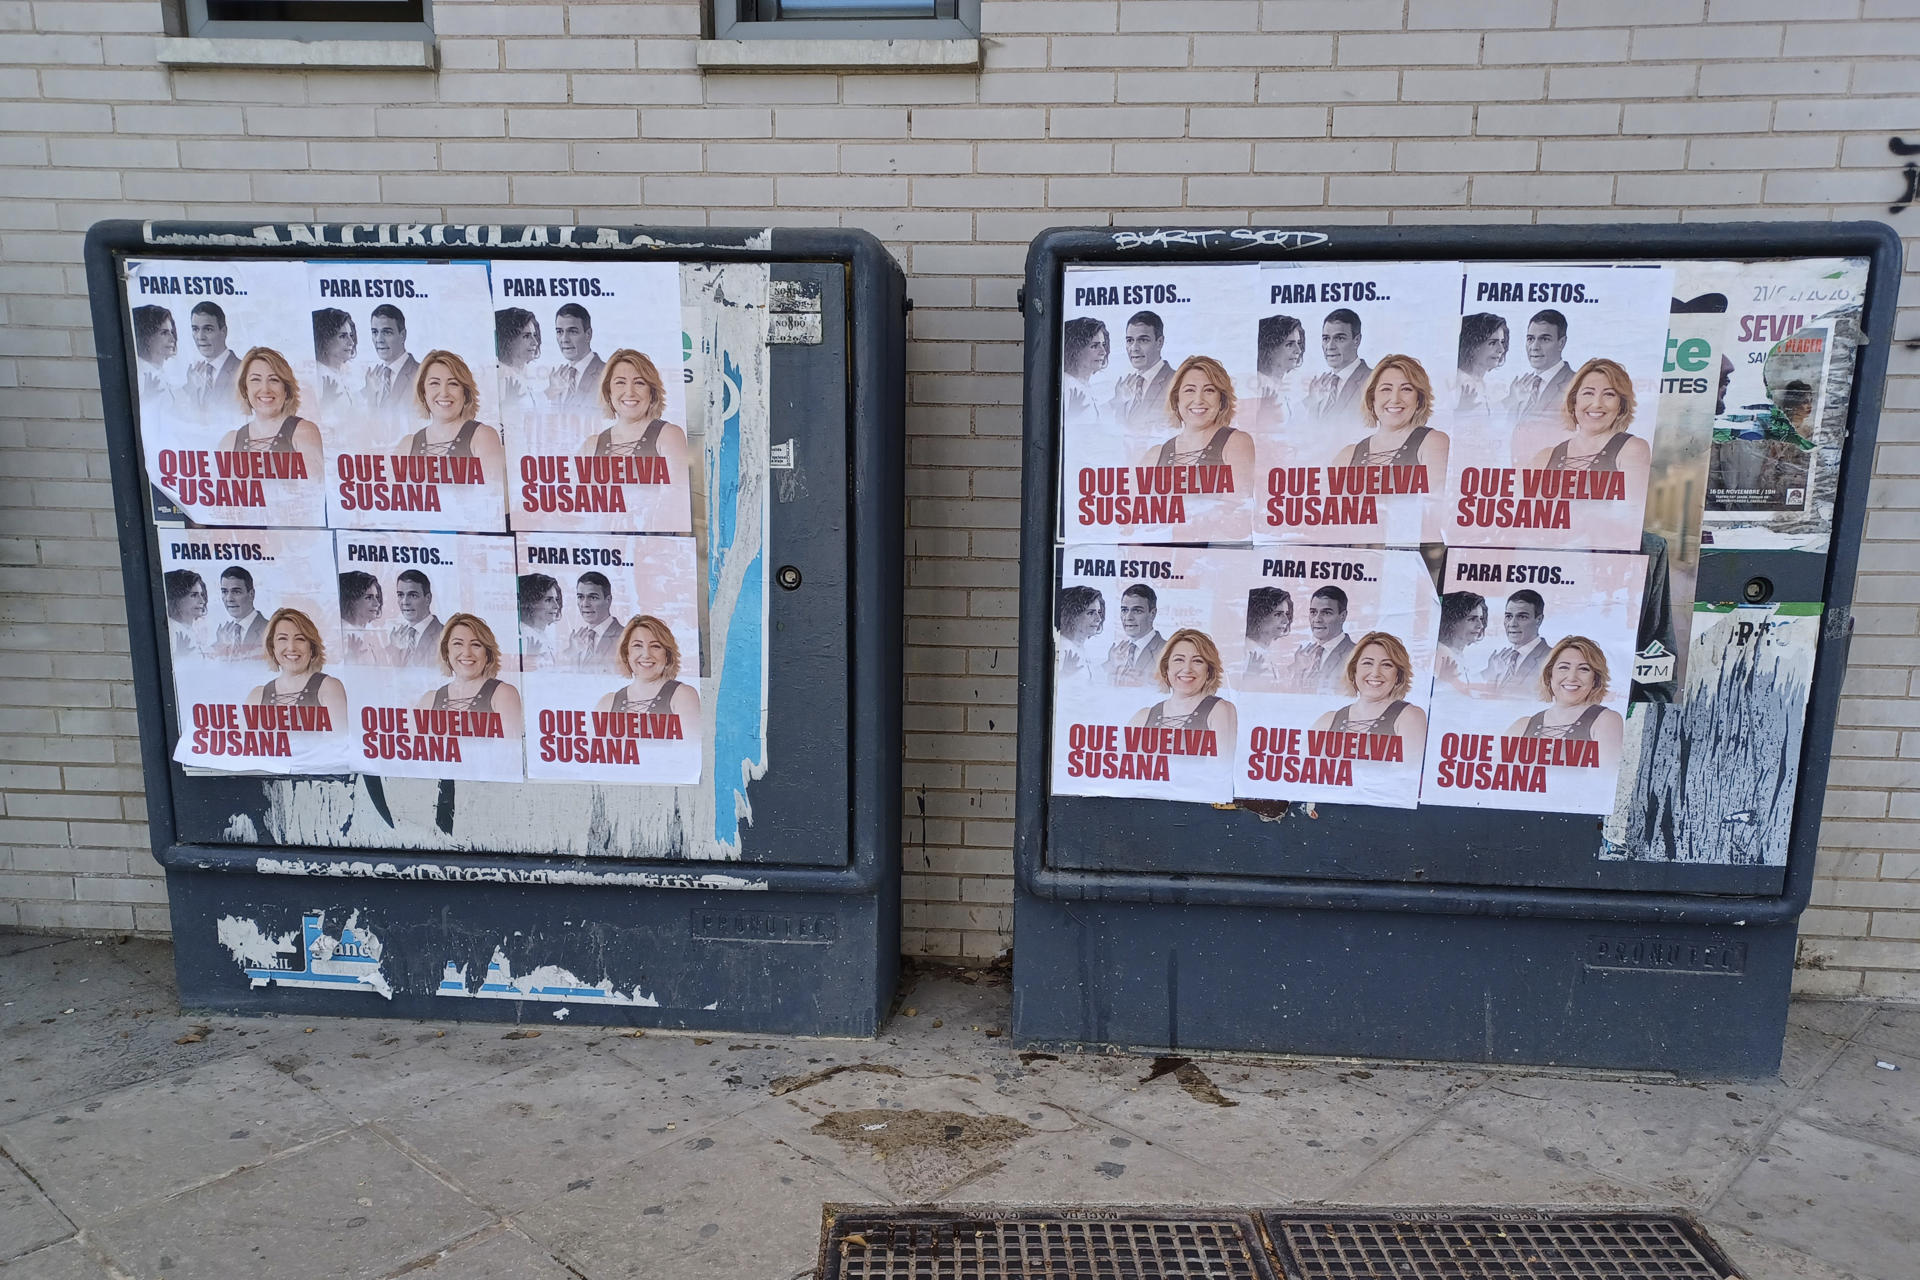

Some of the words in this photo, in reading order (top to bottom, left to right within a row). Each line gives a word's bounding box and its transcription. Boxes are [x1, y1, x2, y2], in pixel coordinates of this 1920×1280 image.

[139, 275, 182, 295] PARA
[183, 276, 248, 296] ESTOS...
[319, 279, 362, 298] PARA
[364, 279, 428, 299] ESTOS...
[503, 278, 547, 297] PARA
[549, 277, 615, 297] ESTOS...
[1075, 286, 1120, 307] PARA
[1123, 283, 1191, 305] ESTOS...
[1270, 283, 1317, 305] PARA
[1320, 281, 1391, 303] ESTOS...
[1476, 282, 1524, 302] PARA
[1527, 282, 1599, 304] ESTOS...
[1660, 378, 1708, 394] TES
[159, 449, 210, 482] QUE
[214, 451, 308, 479] VUELVA
[337, 454, 388, 488] QUE
[391, 455, 485, 485] VUELVA
[520, 455, 571, 487] QUE
[574, 456, 670, 485] VUELVA
[339, 480, 442, 512] SUSANA
[1078, 467, 1129, 499] QUE
[1135, 465, 1235, 494] VUELVA
[1267, 467, 1320, 500] QUE
[1327, 465, 1429, 496] VUELVA
[1460, 467, 1519, 502] QUE
[1522, 469, 1625, 501] VUELVA
[522, 483, 627, 512] SUSANA
[1078, 495, 1186, 525] SUSANA
[1266, 496, 1378, 526] SUSANA
[1456, 498, 1571, 529] SUSANA
[171, 542, 212, 560] PARA
[213, 542, 275, 561] ESTOS...
[347, 543, 389, 563] PARA
[391, 545, 454, 565] ESTOS...
[527, 546, 570, 565] PARA
[572, 547, 634, 567] ESTOS...
[1074, 558, 1117, 577] PARA
[1119, 560, 1184, 580] ESTOS...
[1262, 558, 1307, 579] PARA
[1310, 561, 1377, 582] ESTOS...
[1456, 562, 1502, 583] PARA
[1505, 564, 1575, 585] ESTOS...
[192, 704, 239, 733] QUE
[243, 705, 333, 731] VUELVA
[361, 706, 409, 737] QUE
[413, 709, 505, 738] VUELVA
[539, 709, 587, 740] QUE
[591, 711, 684, 740] VUELVA
[191, 728, 292, 757] SUSANA
[363, 732, 462, 762] SUSANA
[539, 736, 640, 765] SUSANA
[1069, 723, 1118, 754] QUE
[1123, 725, 1217, 757] VUELVA
[1250, 726, 1301, 758] QUE
[1307, 729, 1404, 763] VUELVA
[1440, 732, 1493, 765] QUE
[1500, 735, 1600, 769] VUELVA
[1067, 751, 1170, 782] SUSANA
[1247, 753, 1353, 787] SUSANA
[1437, 761, 1547, 793] SUSANA
